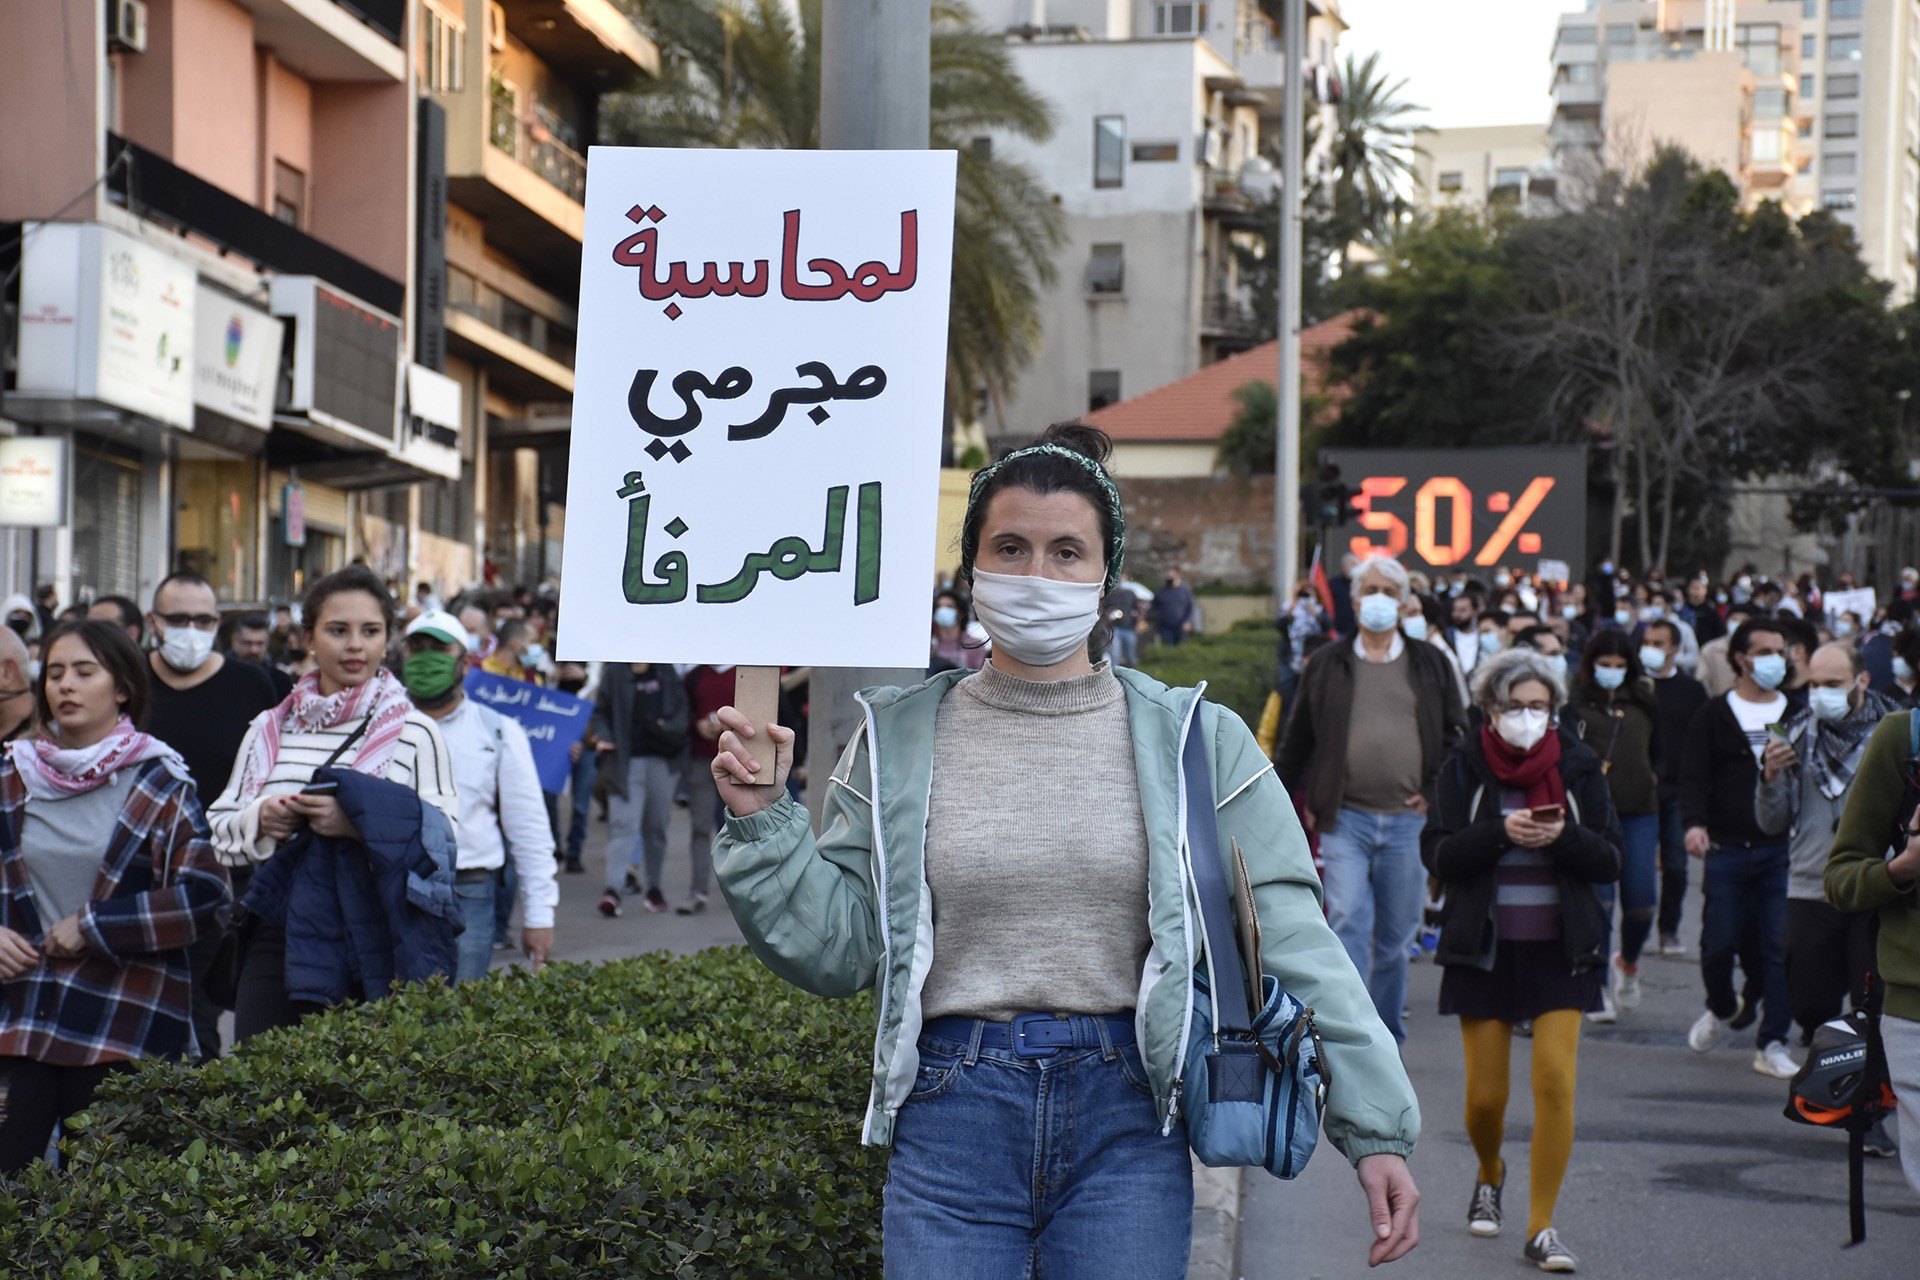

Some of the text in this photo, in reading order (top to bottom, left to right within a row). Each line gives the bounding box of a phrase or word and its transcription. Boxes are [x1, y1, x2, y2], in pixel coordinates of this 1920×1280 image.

[612, 204, 918, 321] لمحاسبة
[628, 360, 888, 464] مجرمي
[616, 471, 882, 607] المرفأ
[1350, 476, 1556, 566] 50%
